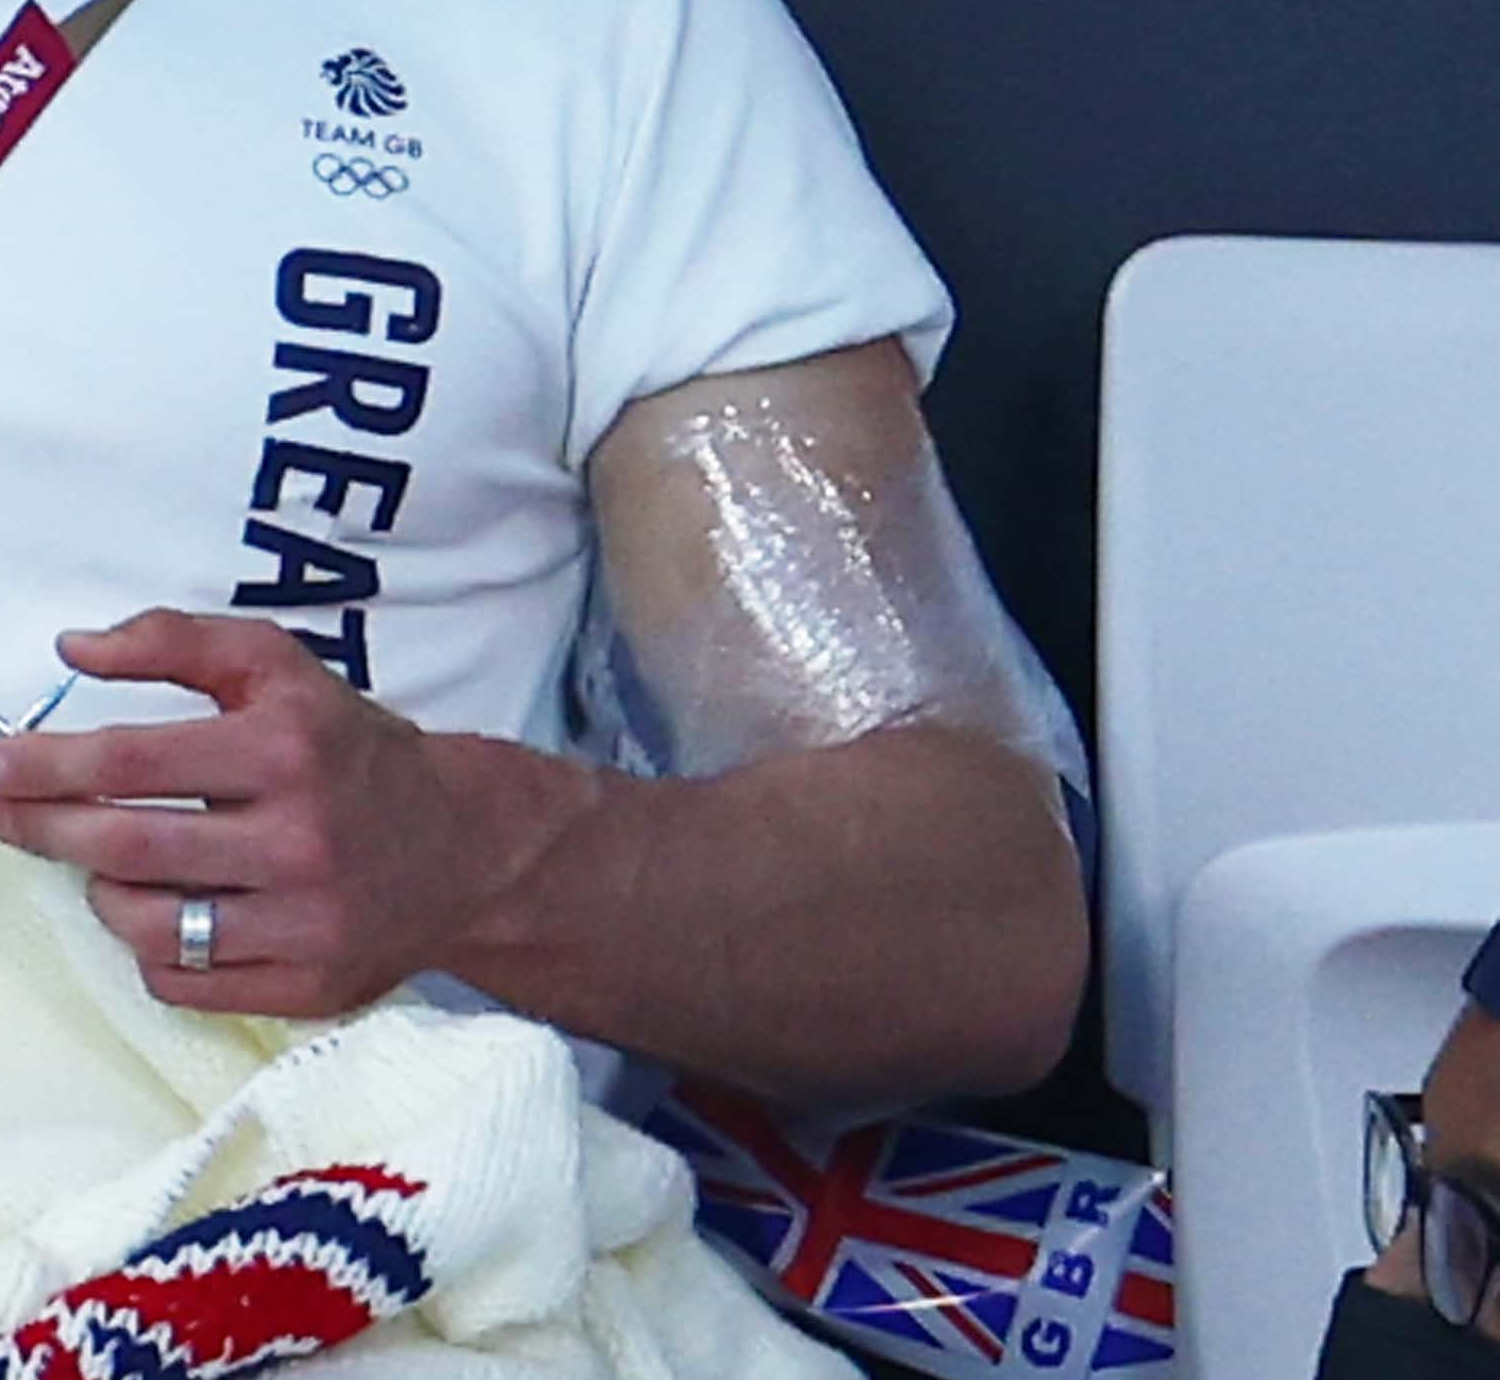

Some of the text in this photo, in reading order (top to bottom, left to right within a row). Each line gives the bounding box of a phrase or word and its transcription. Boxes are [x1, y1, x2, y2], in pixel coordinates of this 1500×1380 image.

[302, 118, 423, 160] TEAM GB
[1021, 1180, 1122, 1368] GBR
